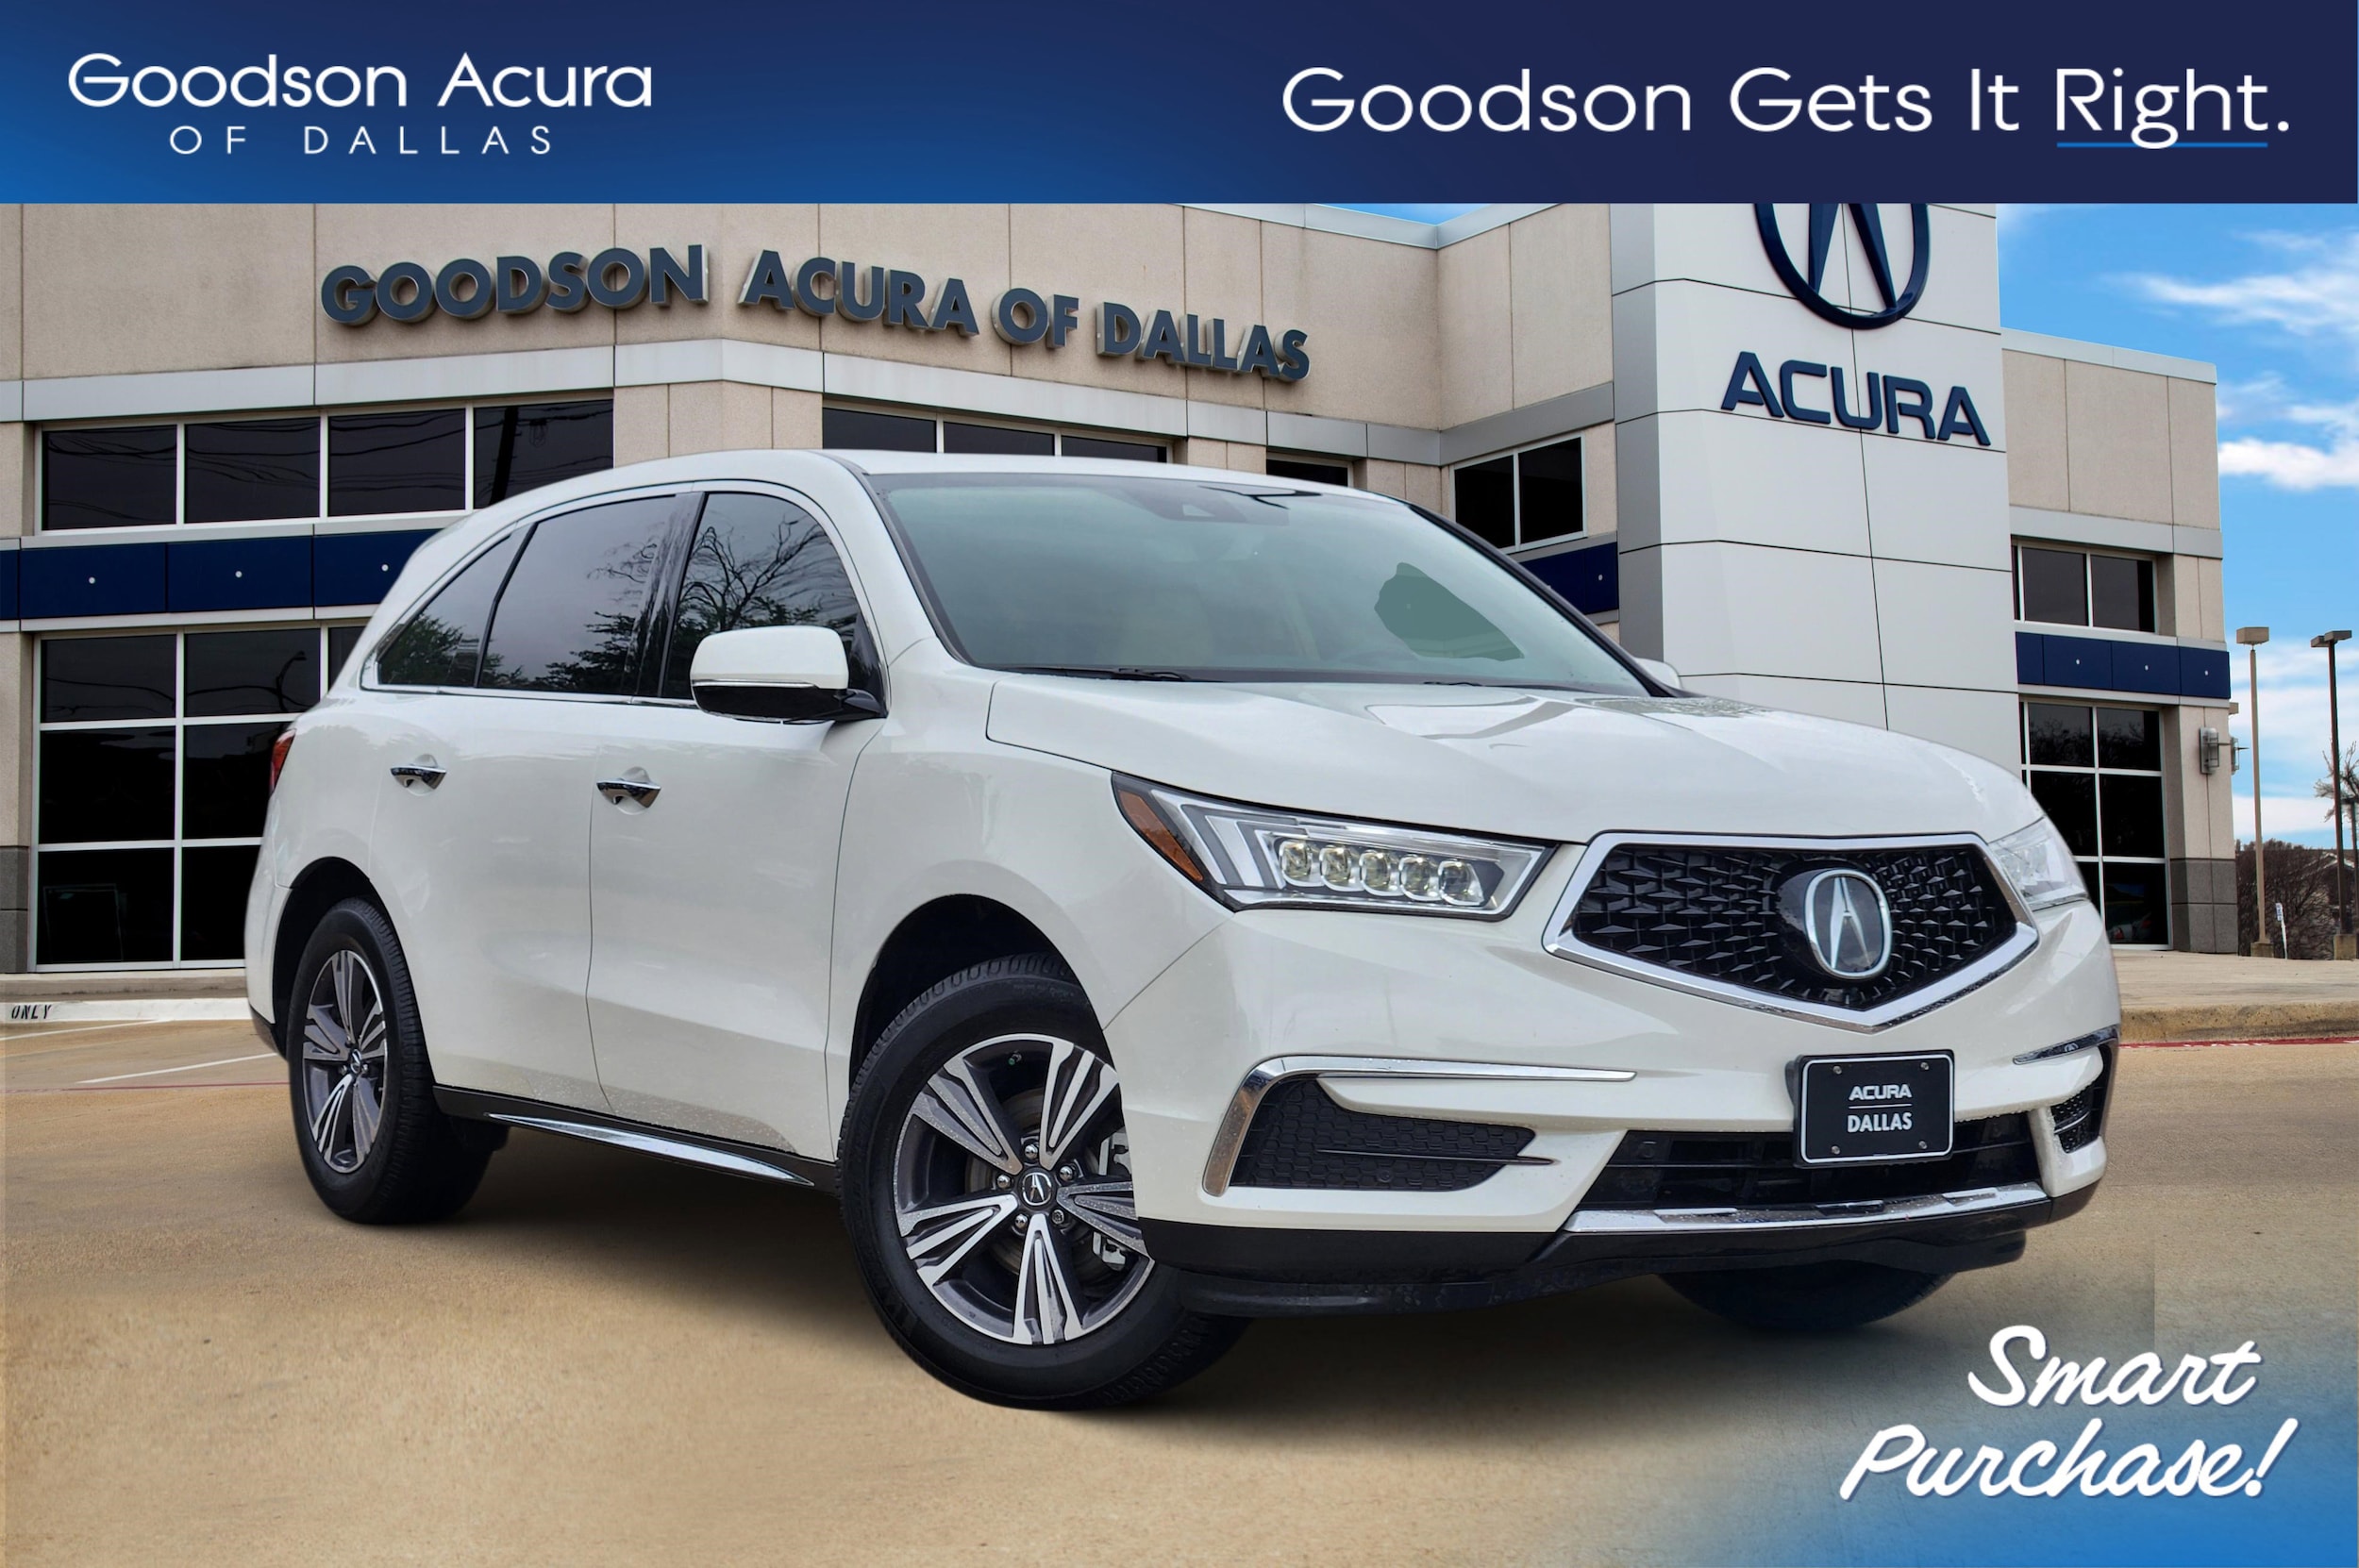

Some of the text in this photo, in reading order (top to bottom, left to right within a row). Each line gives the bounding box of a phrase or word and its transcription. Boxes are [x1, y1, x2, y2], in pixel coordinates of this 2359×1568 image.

[321, 244, 1311, 381] GOODSON ACURA OF DALLAS
[1720, 350, 1992, 446] ACURA
[11, 1004, 53, 1020] ONLY
[1849, 1083, 1913, 1101] ACURA
[1847, 1111, 1913, 1133] DALLAS
